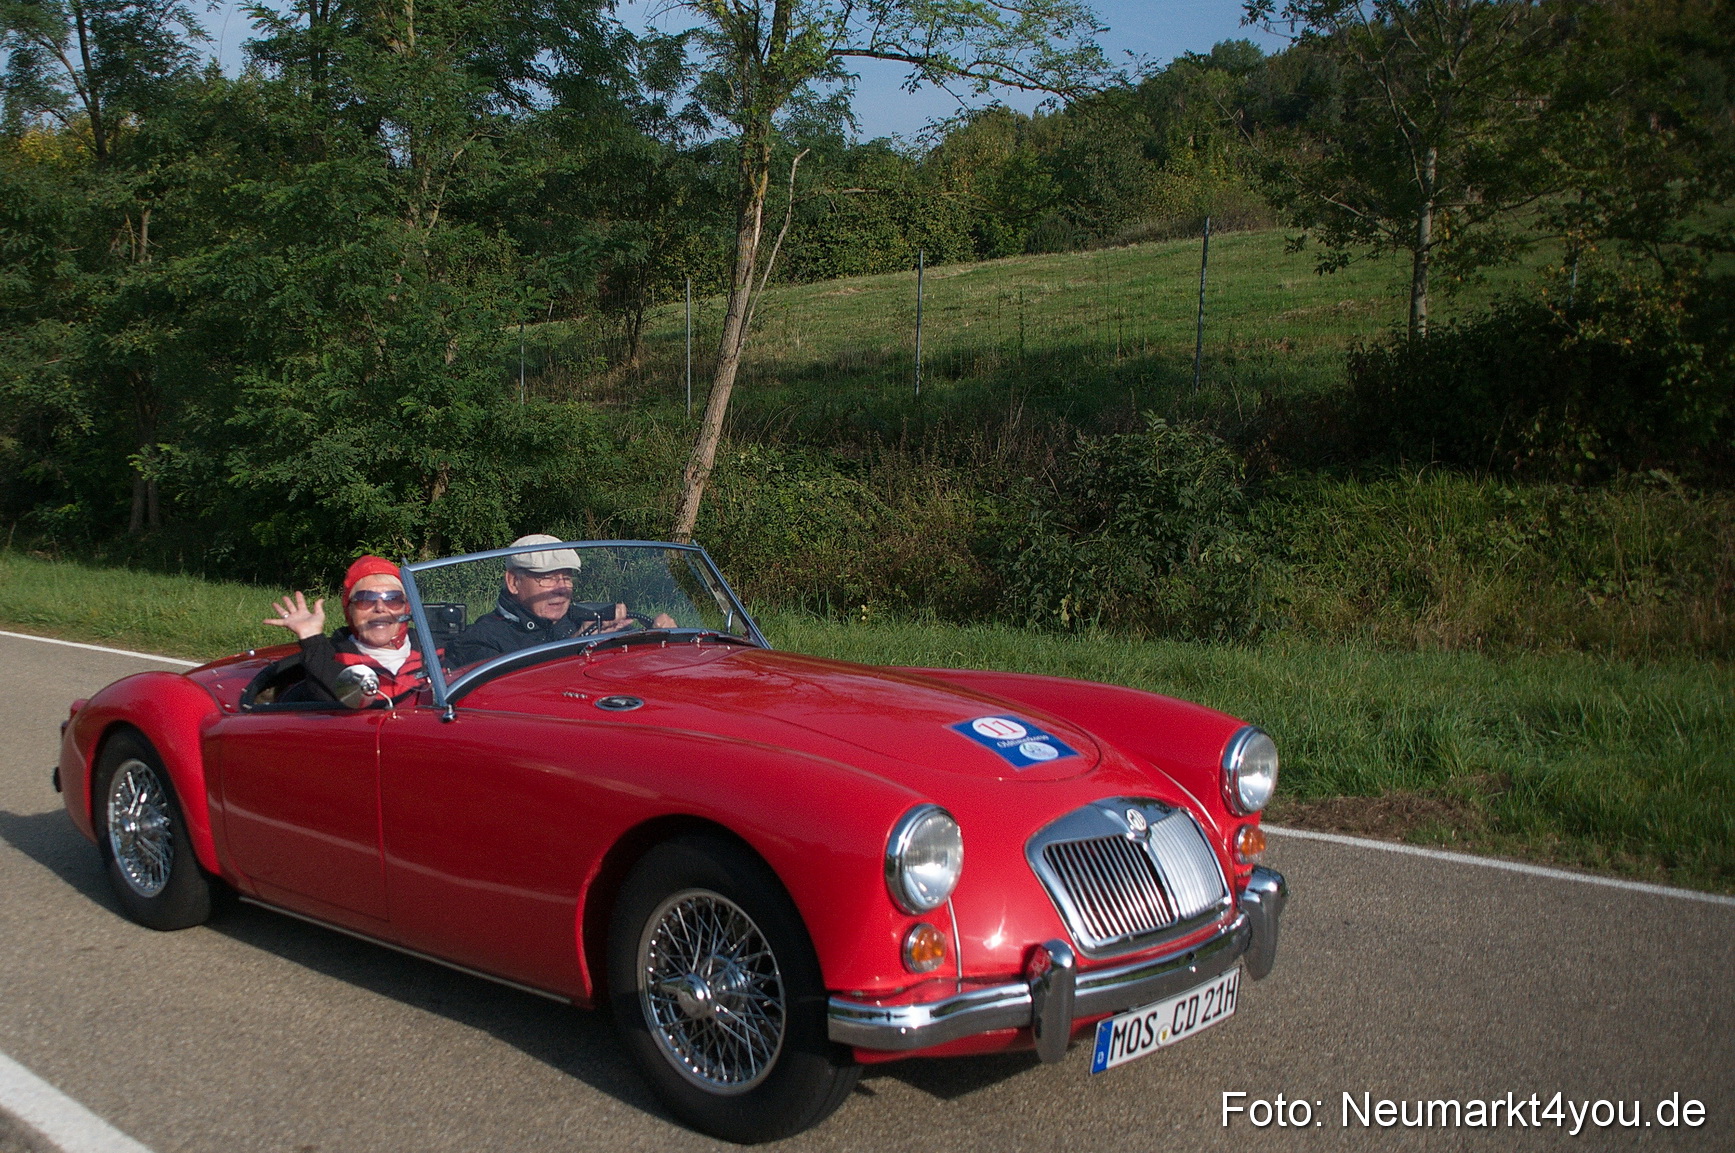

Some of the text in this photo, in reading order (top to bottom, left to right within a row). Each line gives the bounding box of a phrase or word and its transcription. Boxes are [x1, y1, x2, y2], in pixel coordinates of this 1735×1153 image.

[977, 720, 1019, 736] 11
[1110, 974, 1237, 1061] MOS CD 21H
